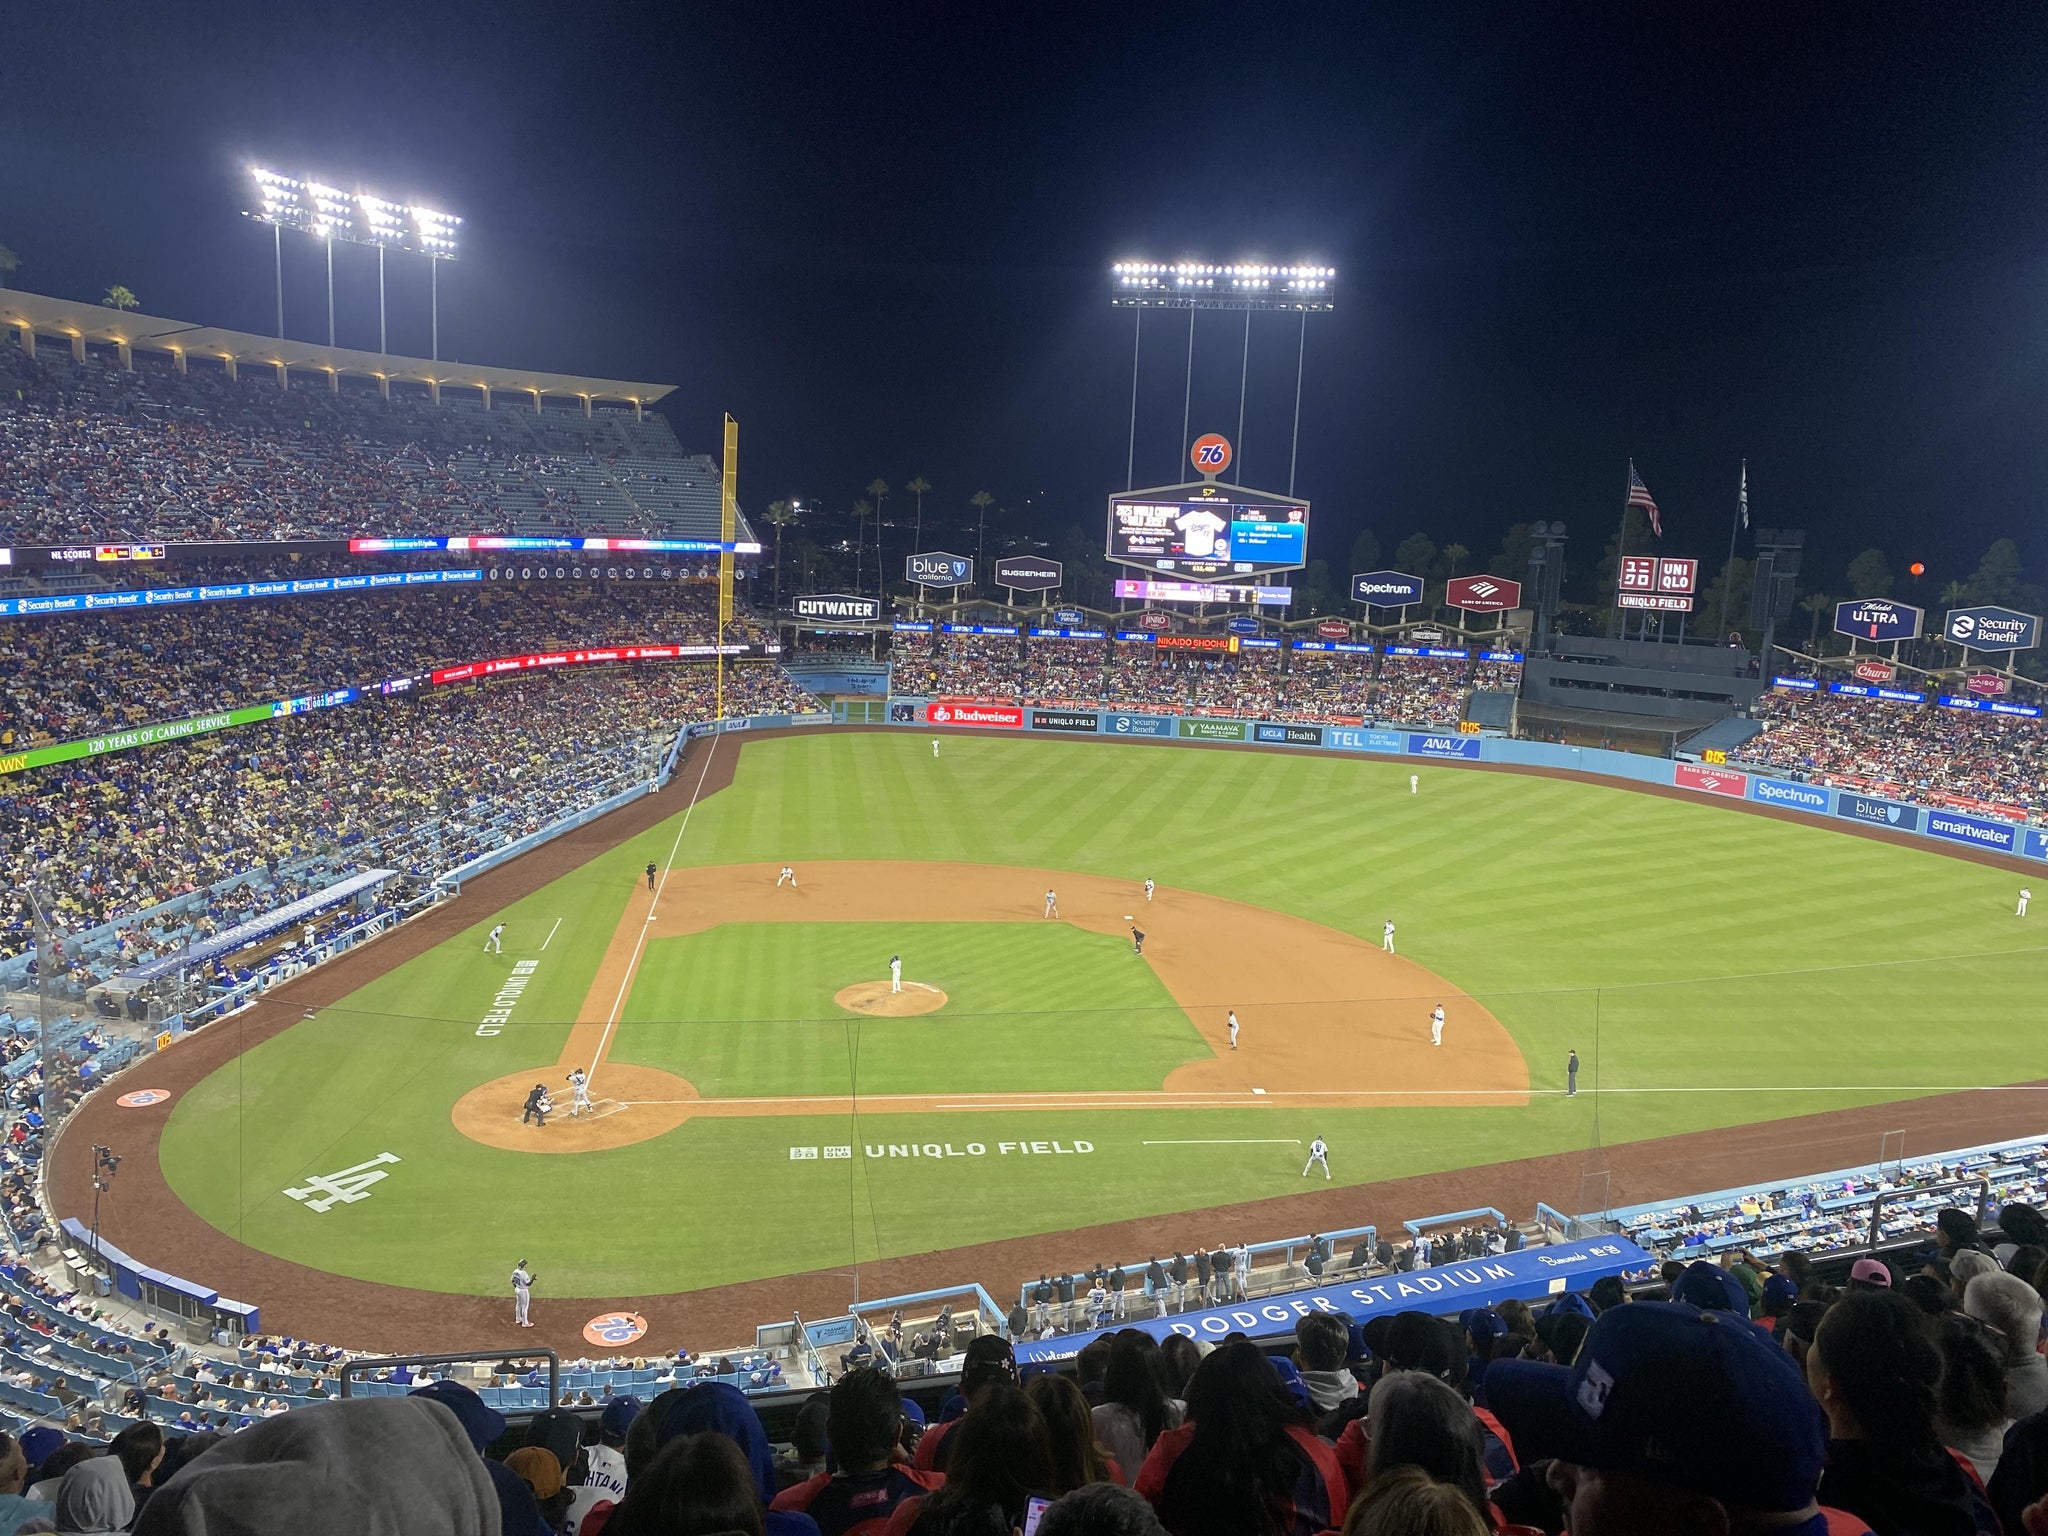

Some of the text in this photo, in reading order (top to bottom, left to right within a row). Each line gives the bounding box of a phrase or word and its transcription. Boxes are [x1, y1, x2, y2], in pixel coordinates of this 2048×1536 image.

[1199, 444, 1224, 464] 76
[51, 551, 62, 559] NL
[64, 550, 91, 559] SCORES
[913, 558, 949, 574] blue
[1664, 563, 1688, 575] UNI
[918, 573, 953, 582] california
[1001, 569, 1056, 578] GUGGENHEIM
[1359, 581, 1411, 594] Spectrum
[1662, 576, 1689, 588] QLO
[152, 590, 193, 602] Security Benefit
[206, 587, 242, 597] Security Benefit
[28, 599, 76, 611] Security Benefit
[94, 595, 138, 606] Security Benefit
[1622, 596, 1687, 609] UNIQLO FIELD
[799, 600, 872, 616] CUTWATER
[1145, 616, 1165, 624] JINRO
[1853, 610, 1898, 624] ULTRA
[1979, 616, 2027, 633] Security
[1977, 629, 2018, 642] Benefit
[1157, 637, 1192, 647] NIKAIDO
[1193, 639, 1228, 648] SHOCHU
[1857, 666, 1890, 679] Churu
[953, 709, 1017, 723] Budweiser
[1049, 717, 1074, 726] UNIQLO
[1132, 718, 1160, 728] Security
[1132, 725, 1156, 734] Benefit
[1461, 722, 1480, 734] 0:05
[88, 715, 231, 753] 120 YEARS OF CARING SERVICE
[1262, 729, 1316, 741] UCLA Health
[1332, 731, 1363, 747] TEL
[1423, 738, 1451, 749] ANA
[1705, 751, 1726, 764] 0:05
[1683, 766, 1700, 774] BANK
[1712, 771, 1739, 780] AMERICA
[1758, 782, 1819, 806] Spectrum
[1856, 800, 1886, 818] blue
[1856, 812, 1885, 822] CALIFORNIA
[1932, 819, 2010, 844] smartwater
[495, 976, 531, 1007] UNIQLO
[475, 1008, 513, 1036] FIELD
[865, 1140, 1095, 1159] UNIQLO FIELD
[282, 1152, 402, 1213] LA
[1170, 1263, 1515, 1339] DODGER STADIUM
[589, 1317, 643, 1342] 76
[585, 1471, 624, 1494] HTANI
